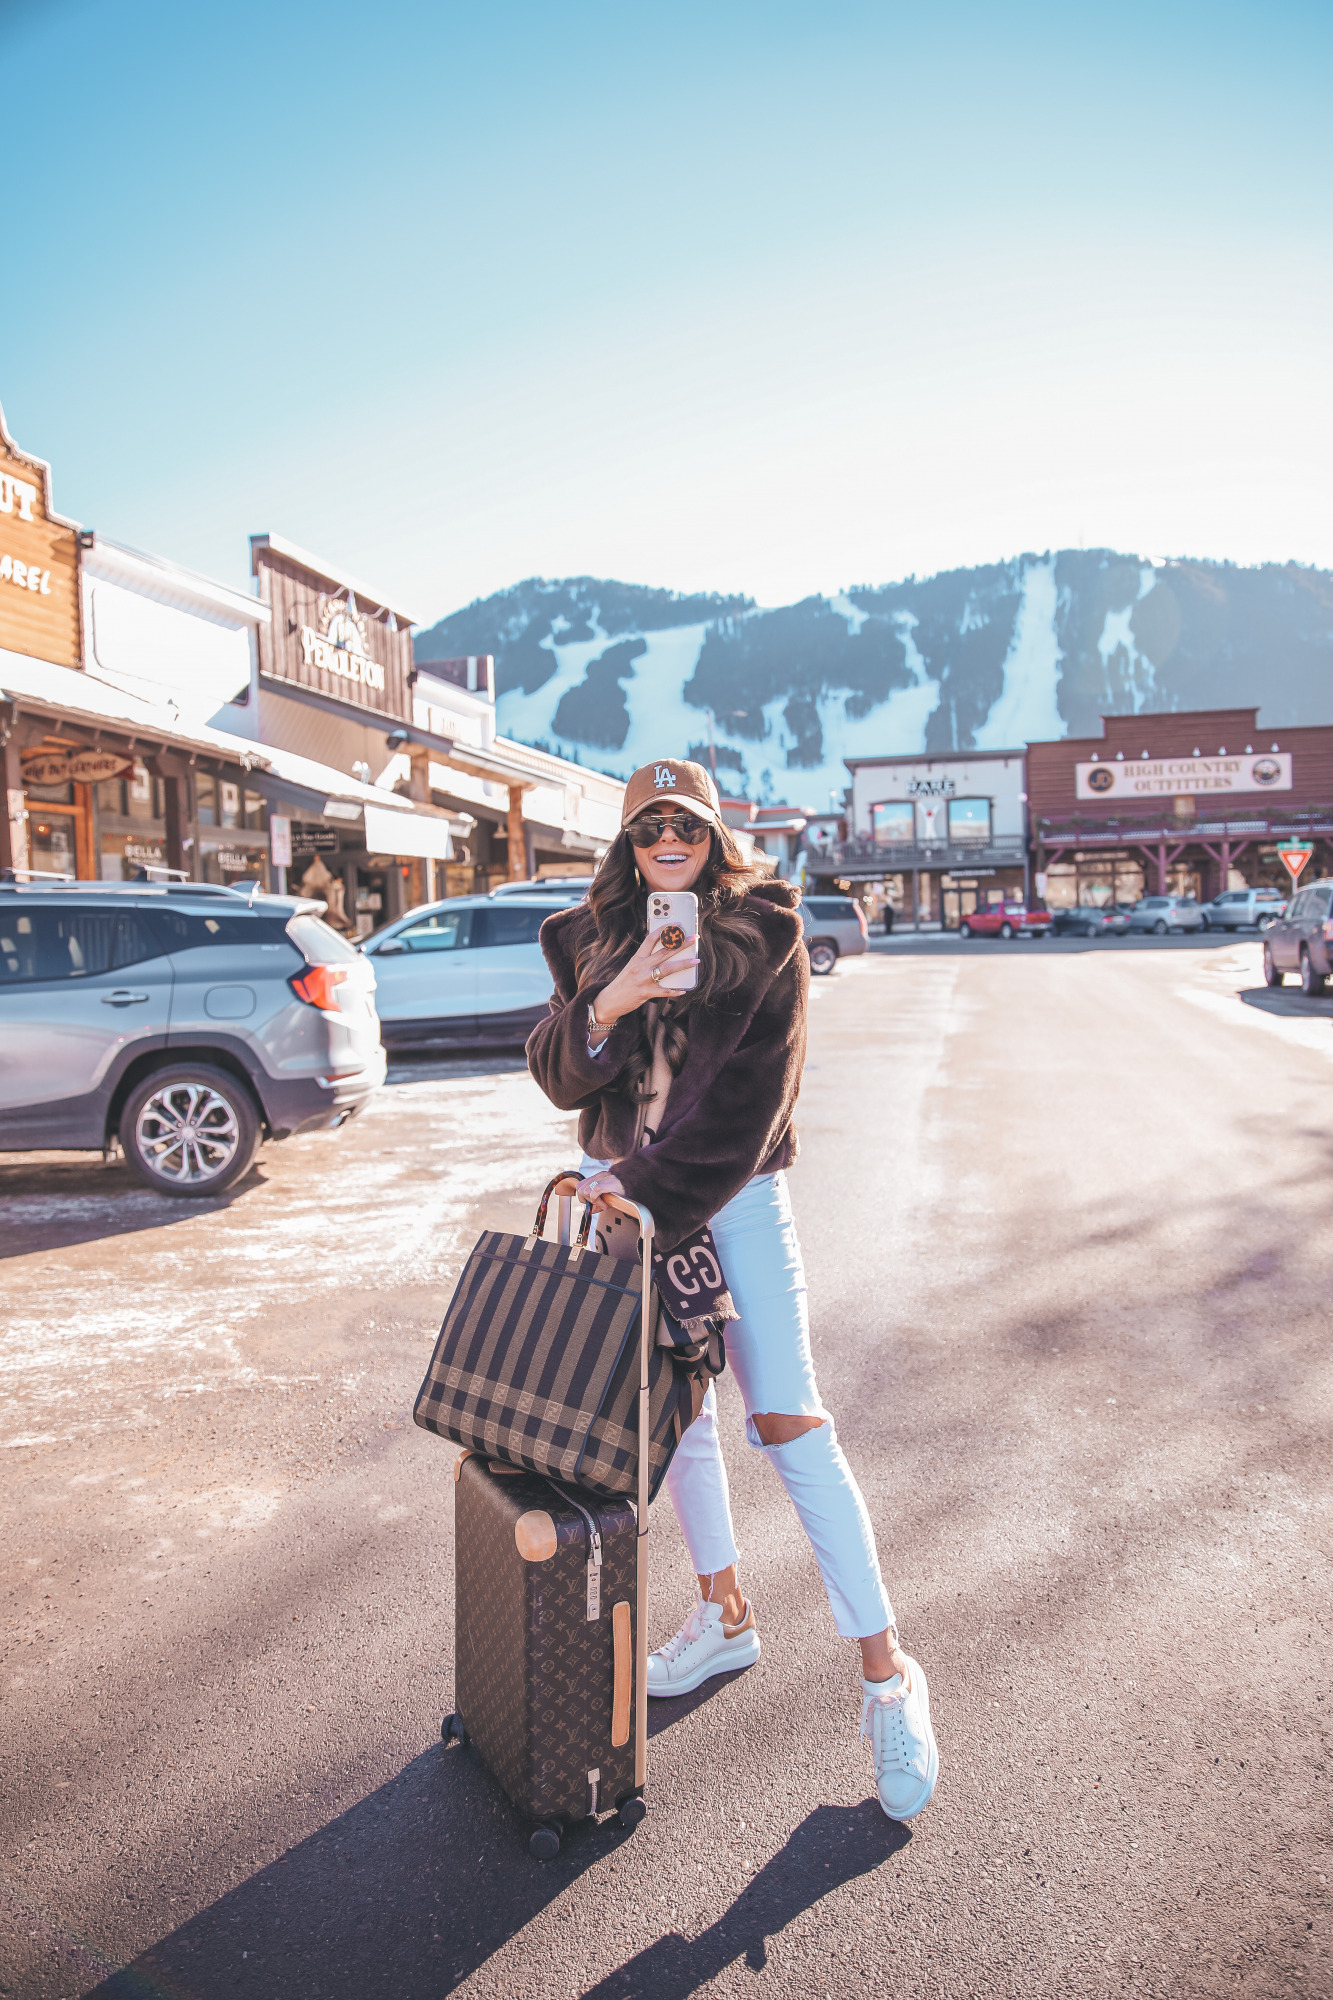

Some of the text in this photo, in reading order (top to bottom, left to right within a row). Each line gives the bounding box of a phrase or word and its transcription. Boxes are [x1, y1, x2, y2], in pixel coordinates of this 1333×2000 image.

[0, 554, 52, 595] AREL
[301, 624, 384, 691] PENDLETON
[653, 764, 677, 788] LA
[1124, 764, 1164, 777] HIGH
[1168, 760, 1242, 775] COUNTRY
[1134, 776, 1232, 792] OUTFITTERS
[125, 844, 161, 858] BELLA
[217, 851, 247, 865] BELLA
